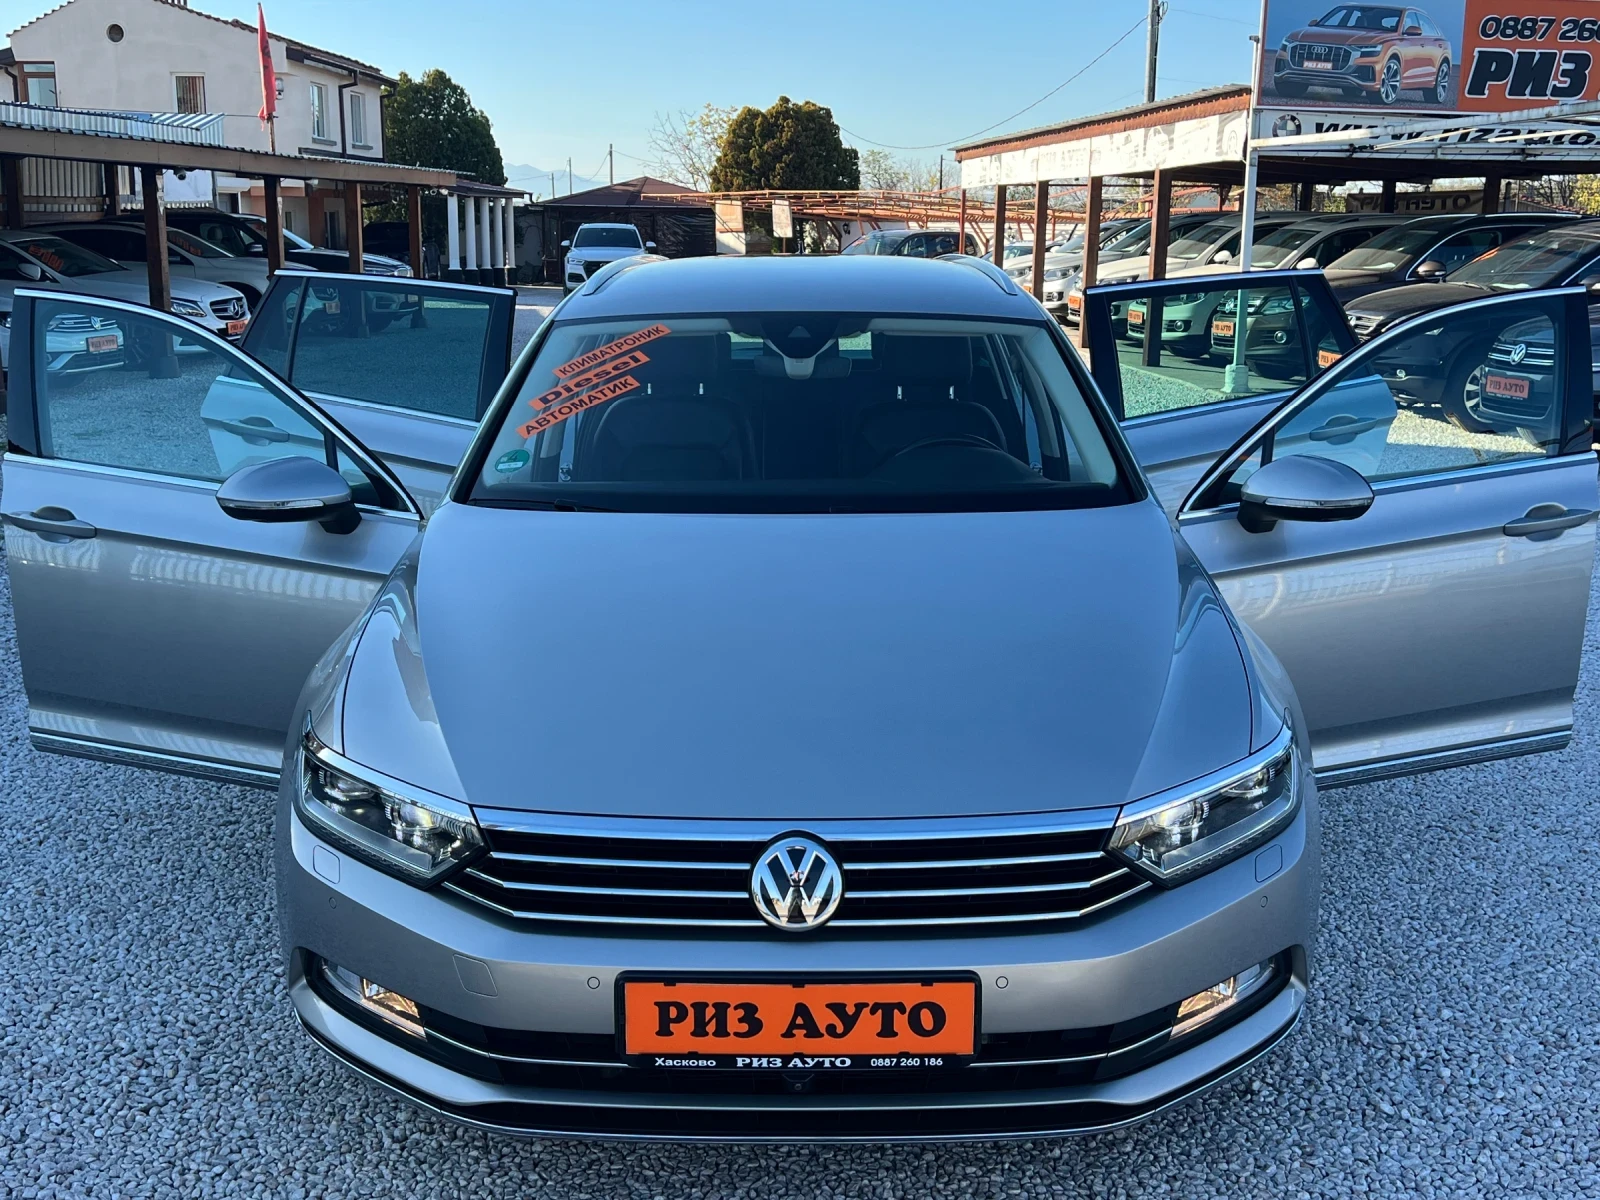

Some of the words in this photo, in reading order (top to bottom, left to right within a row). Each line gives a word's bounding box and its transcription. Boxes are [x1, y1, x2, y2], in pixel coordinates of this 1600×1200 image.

[1479, 15, 1556, 41] 0887
[1557, 17, 1600, 42] 26
[1465, 48, 1592, 100] РИЗ
[558, 325, 665, 376] КЛИМАТРОНИК
[537, 354, 643, 406] Diesel
[1502, 381, 1525, 394] АУТО
[525, 377, 635, 435] АВТОМАТИК
[654, 1001, 764, 1038] РИЗ
[780, 1001, 947, 1039] АУТО
[655, 1057, 716, 1067] Хасково
[736, 1057, 782, 1068] РИЗ
[787, 1057, 852, 1068] АУТО
[870, 1058, 897, 1067] 0887
[900, 1058, 920, 1066] 260
[924, 1057, 943, 1066] 186
